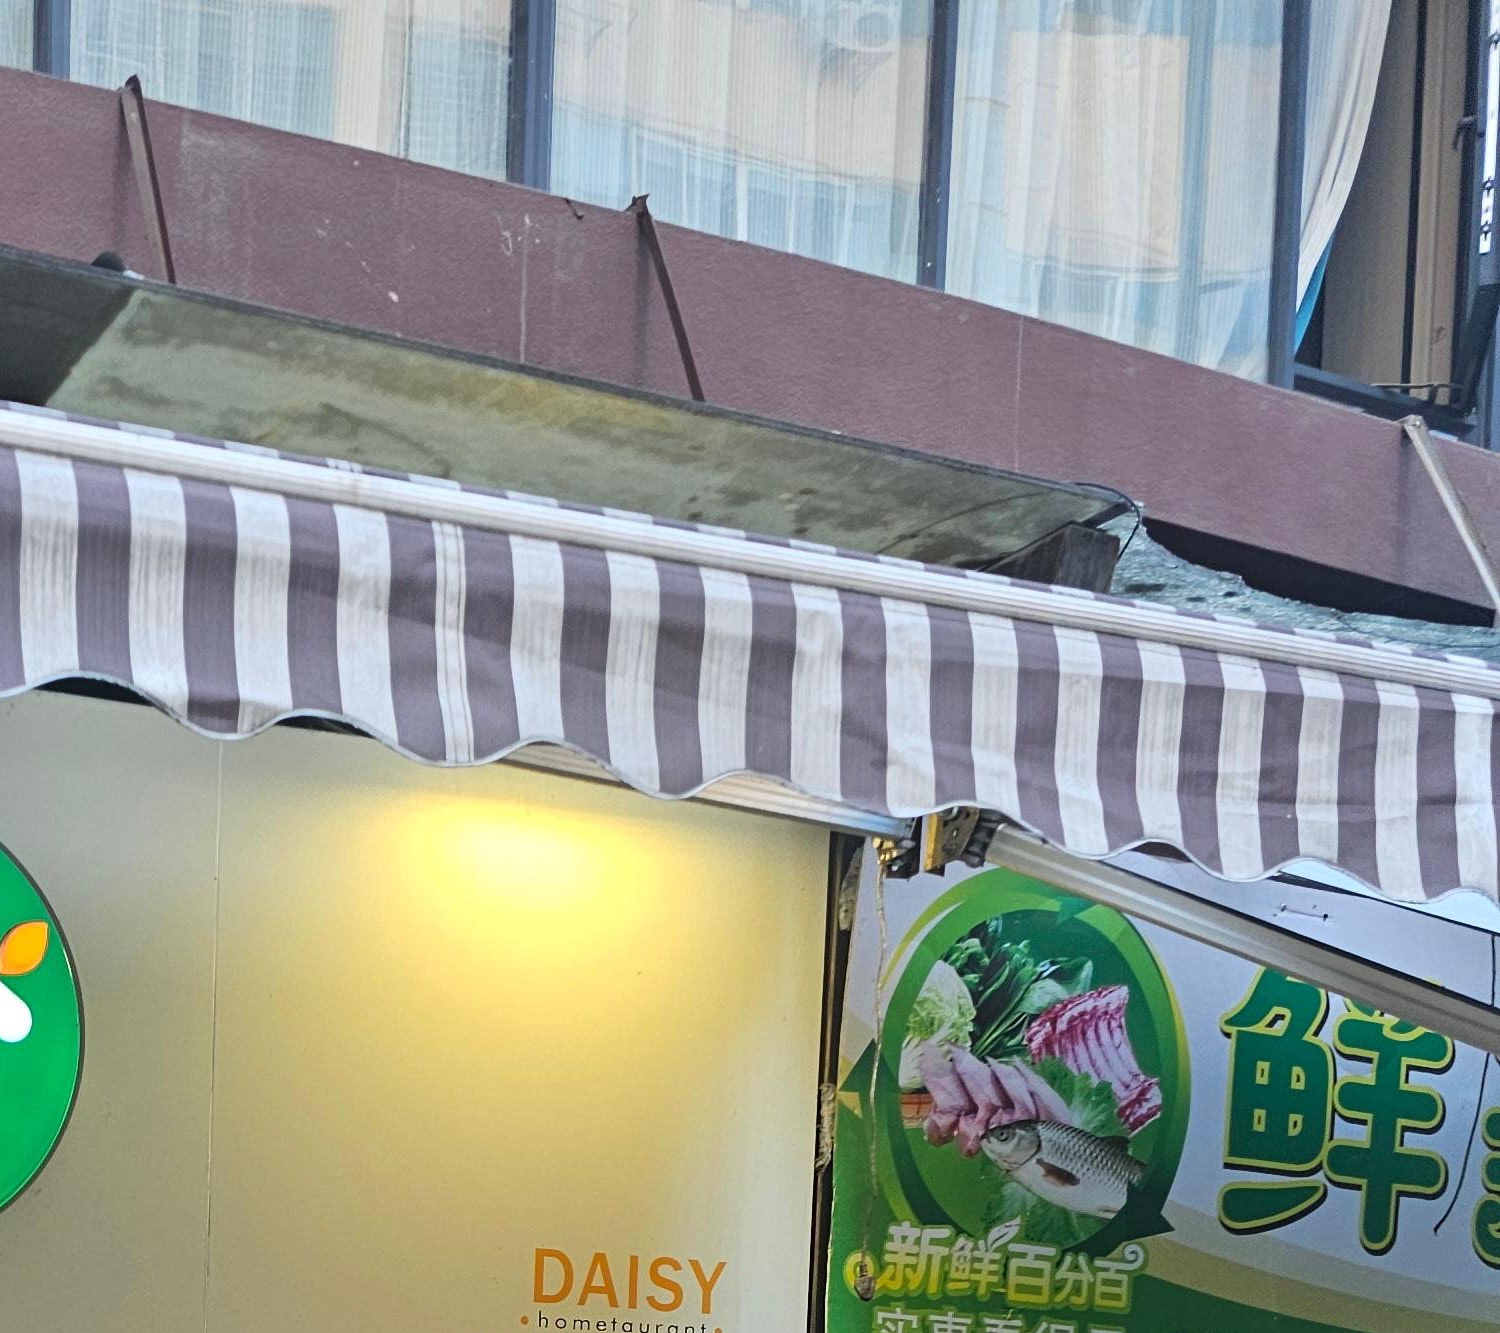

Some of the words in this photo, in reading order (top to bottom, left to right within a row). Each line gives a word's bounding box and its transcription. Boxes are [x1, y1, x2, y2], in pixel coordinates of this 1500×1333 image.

[1218, 965, 1500, 1267] 鲜
[533, 1247, 727, 1315] DAISY
[882, 1220, 1145, 1310] 新鲜百分百
